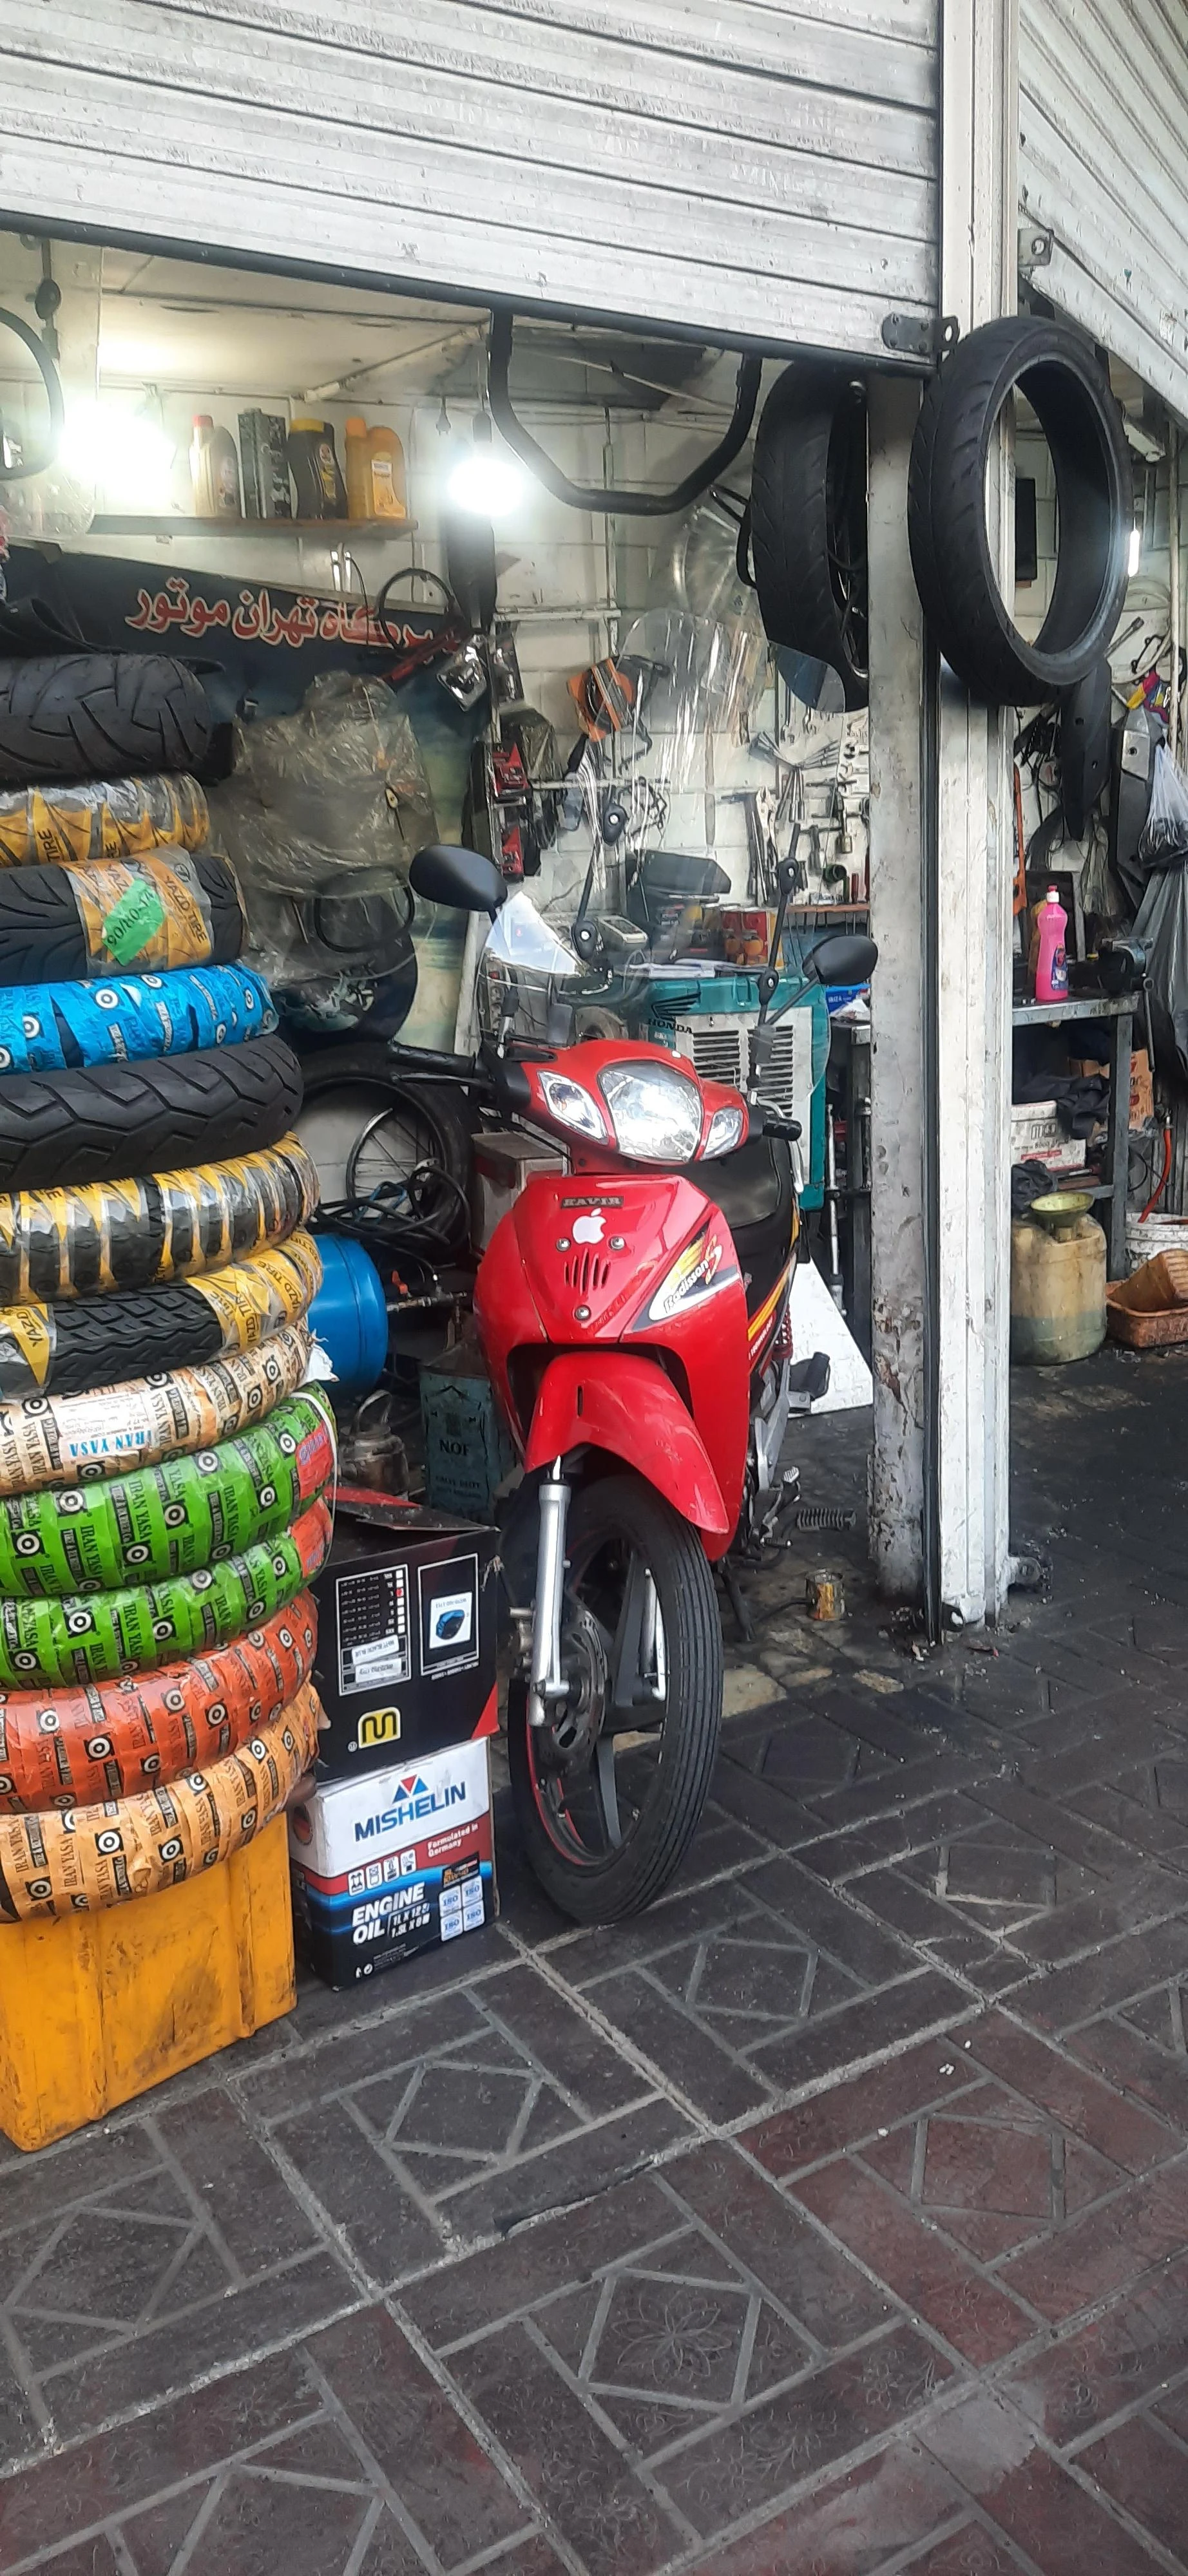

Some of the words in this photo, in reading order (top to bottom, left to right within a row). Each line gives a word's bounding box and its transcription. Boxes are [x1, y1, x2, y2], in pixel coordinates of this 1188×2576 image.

[125, 577, 230, 638] موتور
[233, 589, 320, 649] تهران
[165, 875, 191, 912] YAZD
[189, 909, 207, 944] TIRE
[648, 1018, 693, 1034] HONDA
[257, 1260, 283, 1283] TIRE
[663, 1258, 709, 1314] Radisson
[17, 1311, 43, 1348] YAZD
[150, 1392, 168, 1420] YASA
[21, 1421, 41, 1450] YASA
[69, 1437, 110, 1457] YASA
[1, 1439, 22, 1467] YASA
[28, 1451, 48, 1475] IRAN
[129, 1479, 148, 1510] IRAN
[169, 1468, 187, 1499] YASA
[224, 1485, 238, 1514] IRAN
[80, 1524, 99, 1553] IRAN
[135, 1510, 153, 1540] YASA
[254, 1568, 269, 1598] YASA
[122, 1602, 140, 1632] IRAN
[353, 1781, 467, 1842] MISHELIN
[12, 1849, 30, 1873] IRAN
[60, 1837, 75, 1864] YASA
[428, 1839, 463, 1858] Germany
[62, 1864, 77, 1888] IRAN
[95, 1859, 111, 1884] YASA
[352, 1881, 425, 1927] ENGINE
[352, 1918, 386, 1945] OIL
